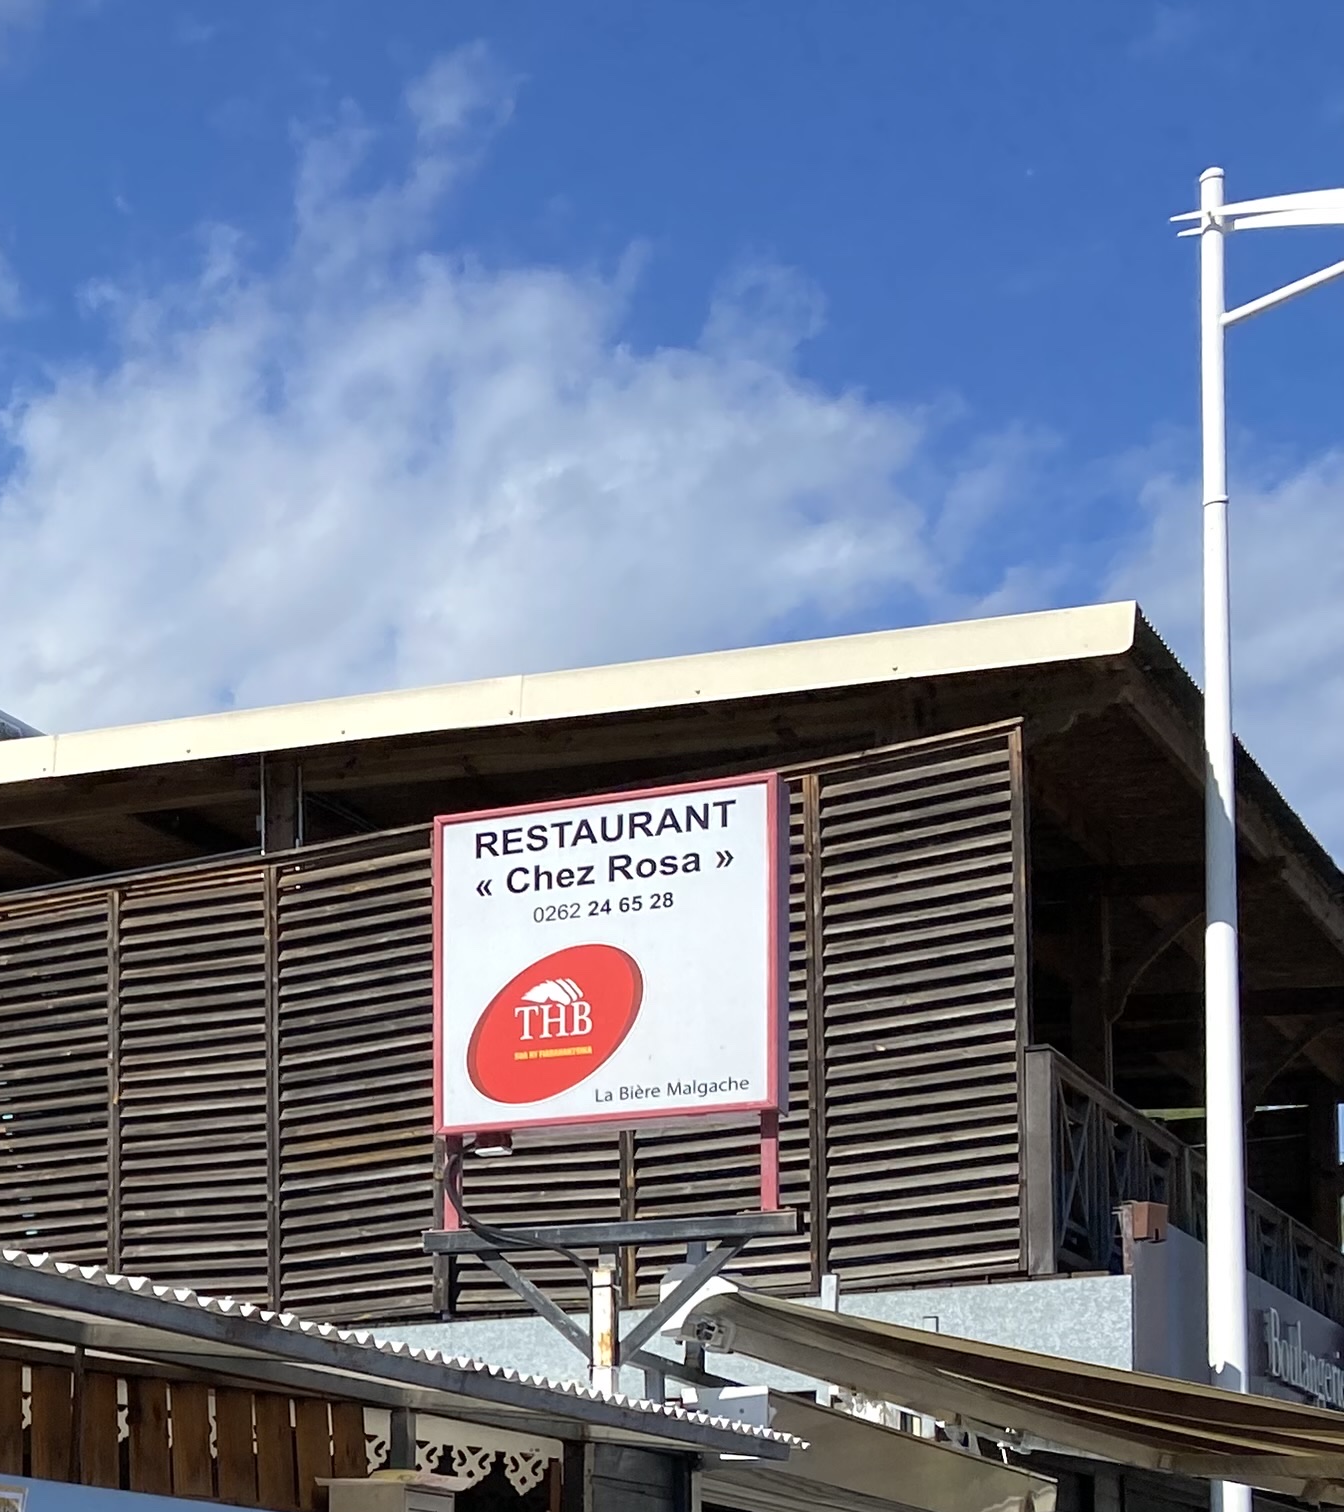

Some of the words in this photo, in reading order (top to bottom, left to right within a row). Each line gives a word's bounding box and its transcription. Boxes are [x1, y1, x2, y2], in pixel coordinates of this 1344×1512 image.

[475, 799, 737, 859] RESTAURANT
[506, 862, 595, 895] Chez
[608, 850, 701, 883] Rosa
[533, 902, 581, 923] 0262
[588, 899, 612, 918] 24
[619, 895, 643, 914] 65
[650, 892, 674, 910] 28
[514, 1001, 593, 1041] THB
[595, 1089, 613, 1103] La
[619, 1083, 661, 1101] Bière
[667, 1077, 750, 1098] Malgache
